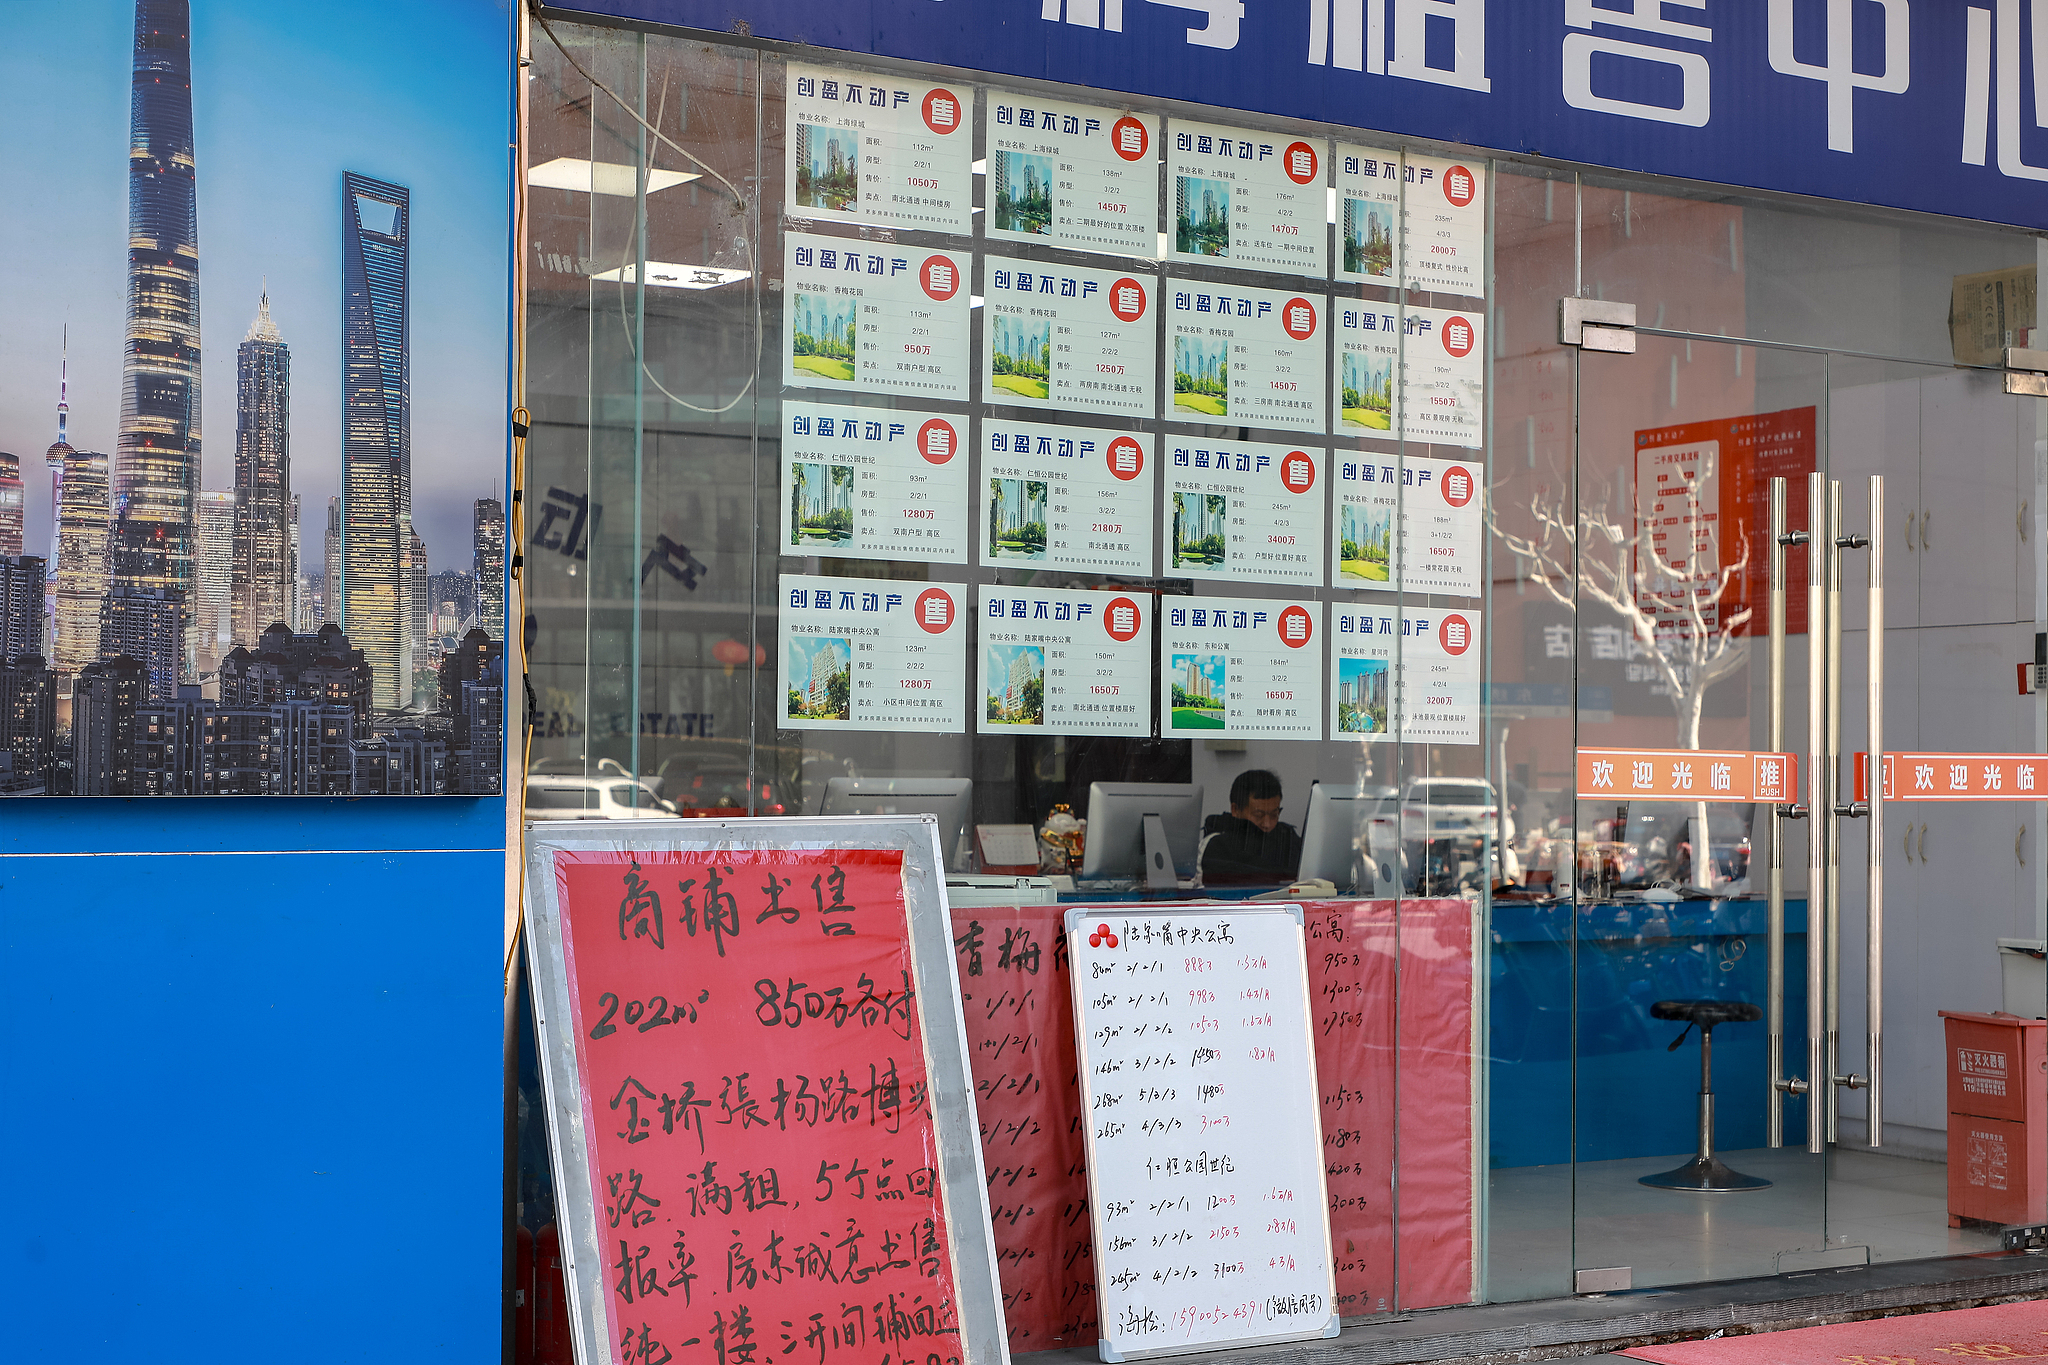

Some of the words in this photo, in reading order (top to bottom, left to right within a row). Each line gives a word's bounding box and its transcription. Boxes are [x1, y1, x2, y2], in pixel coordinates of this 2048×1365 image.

[797, 76, 909, 109] 创盈不动产
[930, 97, 954, 127] 售
[834, 116, 866, 130] 上海绿城
[996, 105, 1100, 136] 创盈不动产
[1119, 125, 1142, 154] 售
[1031, 143, 1060, 156] 上海绿城
[1177, 132, 1273, 161] 创盈不动产
[912, 159, 931, 170] 2/2/1
[1291, 150, 1312, 178] 售
[1209, 168, 1237, 181] 上海绿城
[906, 176, 939, 190] 1050万
[1102, 184, 1121, 195] 3/2/2
[1449, 173, 1469, 200] 售
[1374, 191, 1399, 203] 上海绿城
[1096, 200, 1128, 214] 1450万
[1276, 208, 1294, 218] 4/2/2
[1270, 222, 1299, 236] 1470万
[1435, 229, 1452, 239] 4/3/3
[1429, 244, 1457, 257] 2000万
[795, 246, 907, 277] 创盈不动产
[928, 264, 952, 293] 售
[994, 269, 1098, 299] 创盈不动产
[833, 285, 864, 297] 香梅花园
[1117, 286, 1139, 315] 售
[1175, 291, 1272, 318] 创盈不动产
[1028, 306, 1057, 319] 香梅花园
[1289, 306, 1310, 333] 售
[911, 326, 930, 336] 2/2/1
[1207, 326, 1235, 338] 香梅花园
[1448, 324, 1468, 350] 售
[903, 343, 932, 356] 950万
[1100, 346, 1119, 357] 2/2/2
[1373, 344, 1399, 356] 香梅花园
[1094, 362, 1126, 376] 1250万
[1274, 364, 1292, 374] 3/2/2
[1269, 380, 1298, 392] 1450万
[1434, 380, 1451, 390] 3/2/2
[1429, 395, 1457, 408] 1550万
[793, 415, 905, 442] 创盈不动产
[926, 427, 950, 456] 售
[991, 432, 1095, 459] 创盈不动产
[830, 452, 876, 465] 仁恒公园世纪
[1114, 445, 1137, 473] 售
[1174, 448, 1270, 472] 创盈不动产
[1026, 468, 1069, 481] 仁恒公园世纪
[1288, 459, 1309, 486] 售
[1205, 482, 1245, 496] 仁恒公园世纪
[1448, 474, 1468, 500] 售
[908, 490, 928, 500] 2/2/1
[1372, 495, 1397, 507] 香梅花园
[901, 508, 936, 520] 1280万
[1097, 505, 1117, 515] 3/2/2
[1090, 522, 1123, 535] 2180万
[1272, 518, 1290, 528] 4/2/3
[1266, 533, 1296, 546] 3400万
[1429, 530, 1453, 540] 3+1/2/2
[1428, 546, 1456, 558] 1650万
[790, 588, 902, 612] 创盈不动产
[923, 597, 947, 625] 售
[988, 598, 1092, 621] 创盈不动产
[1111, 606, 1134, 633] 售
[1170, 608, 1267, 629] 创盈不动产
[827, 624, 880, 637] 陆家嘴中央公寓
[1285, 614, 1306, 640] 售
[1023, 633, 1072, 644] 陆家嘴中央公寓
[1446, 622, 1465, 648] 售
[1203, 640, 1230, 652] 东和公寓
[1370, 647, 1389, 658] 星河湾
[905, 661, 926, 671] 2/2/2
[1095, 667, 1114, 677] 3/2/2
[898, 678, 932, 690] 1280万
[1270, 673, 1289, 683] 3/2/2
[1431, 679, 1448, 688] 4/2/4
[1089, 684, 1120, 696] 1650万
[1265, 689, 1294, 701] 1650万
[1425, 695, 1454, 706] 3200万
[1592, 760, 1731, 791] 欢迎光临
[1760, 760, 1780, 786] 推
[1914, 763, 2036, 791] 欢迎光临
[1760, 787, 1780, 798] PUSH
[618, 860, 856, 958] 商铺出售
